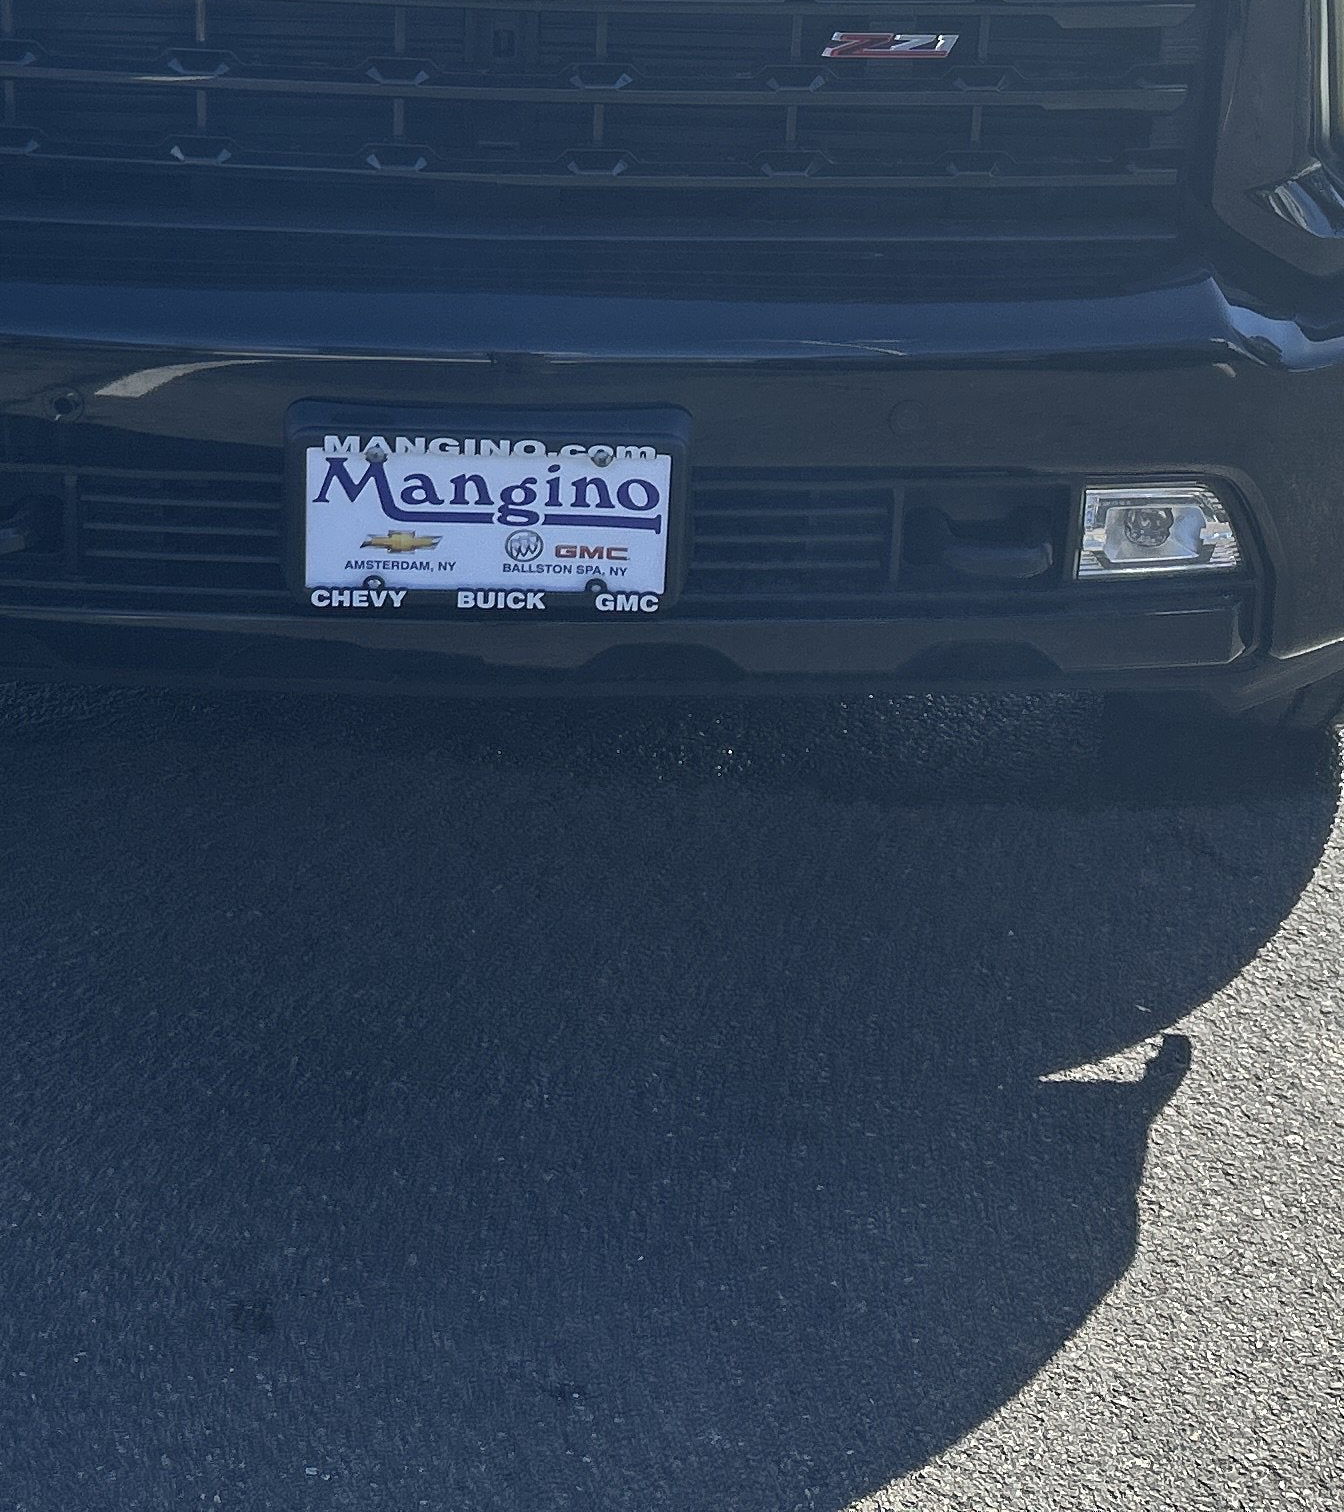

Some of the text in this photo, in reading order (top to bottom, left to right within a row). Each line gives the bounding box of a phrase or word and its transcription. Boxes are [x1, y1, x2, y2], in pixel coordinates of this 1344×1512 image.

[822, 31, 960, 58] Z71
[323, 434, 657, 461] MANGINO.com
[312, 456, 662, 534] Mangino
[554, 544, 631, 561] GMC
[344, 560, 457, 573] AMSTERDAM, NY
[502, 563, 628, 577] BALLSTON SPA, NY
[310, 589, 660, 613] CHEVY BUICK GMC
